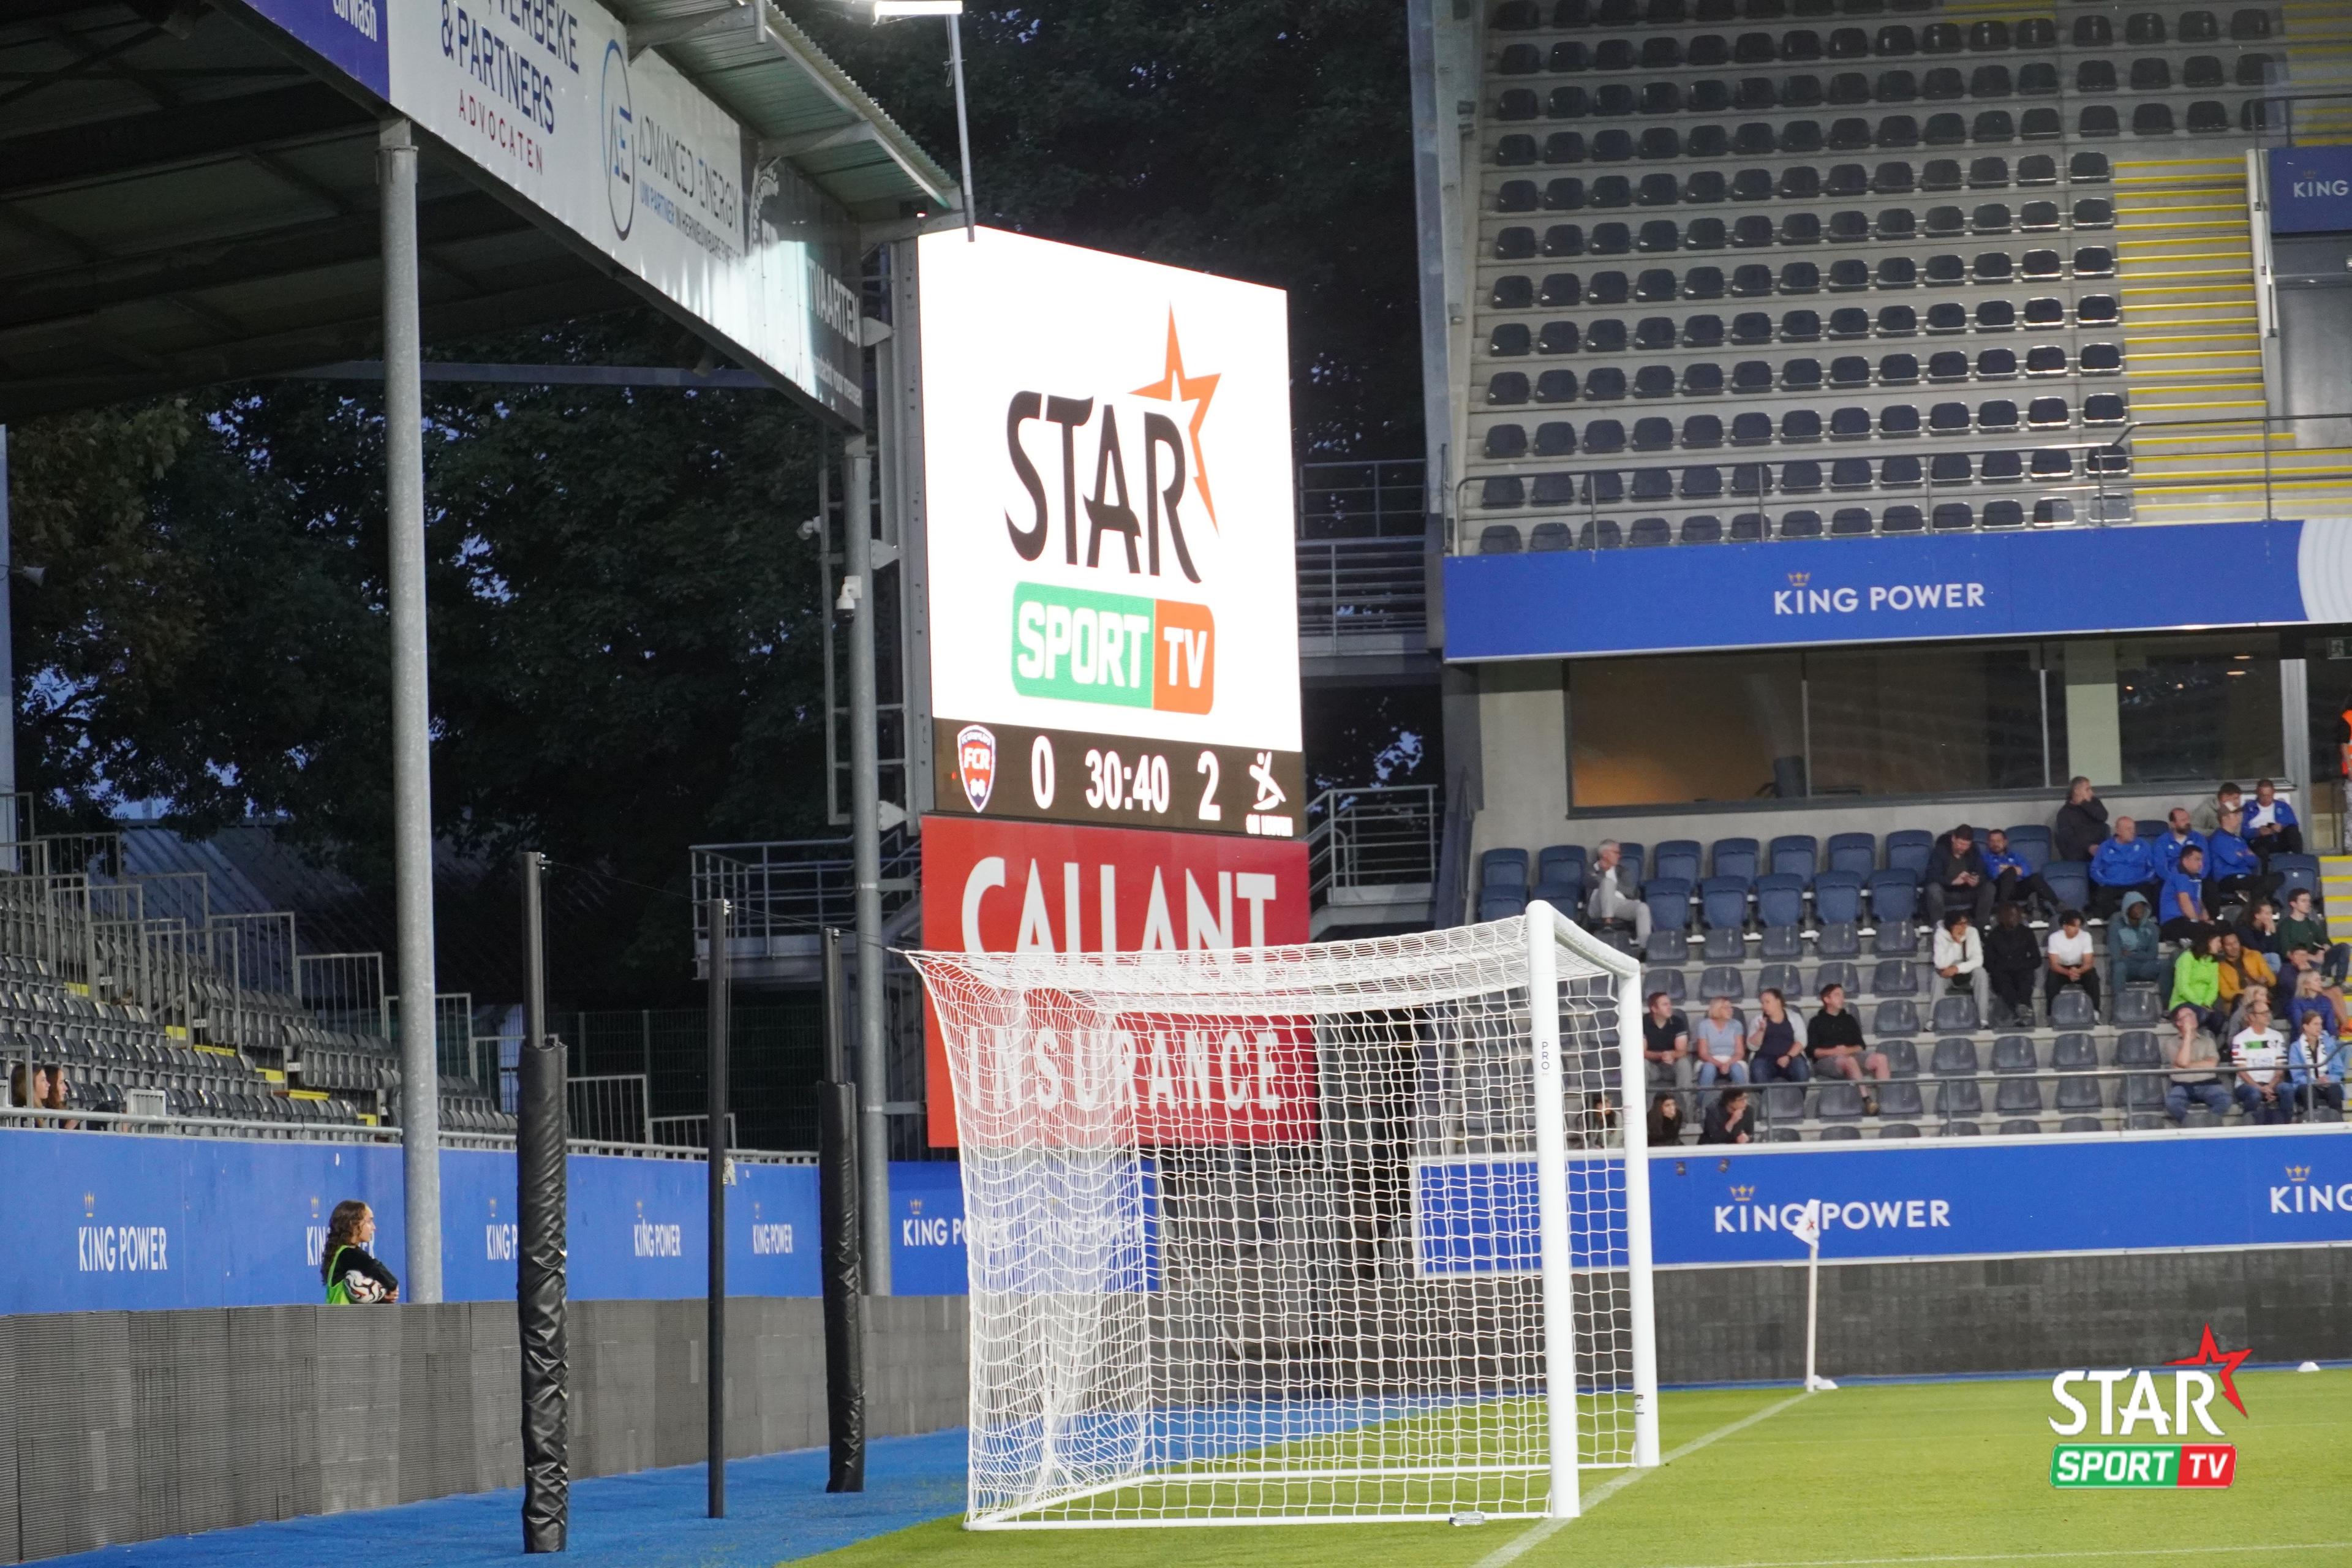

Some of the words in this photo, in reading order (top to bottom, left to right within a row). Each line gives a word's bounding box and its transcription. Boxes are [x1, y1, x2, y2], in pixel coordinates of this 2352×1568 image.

[441, 0, 454, 61] &
[458, 7, 554, 135] PARTNERS
[459, 89, 543, 176] ADVOCATEN
[2293, 179, 2350, 198] KING
[1005, 390, 1202, 584] STAR
[1774, 588, 1859, 615] KING
[1870, 582, 1985, 611] POWER
[1017, 600, 1150, 689] SPORT
[1163, 625, 1208, 689] TV
[1031, 735, 1055, 810] 0
[1085, 749, 1170, 814] 30:40
[1197, 750, 1221, 821] 2
[968, 1027, 1281, 1111] INSURANCE
[1541, 1041, 1550, 1070] PRO
[903, 1218, 948, 1246] KING
[1715, 1203, 1808, 1233] KING
[1822, 1200, 1951, 1231] POWER
[78, 1226, 116, 1272] KING
[119, 1226, 167, 1272] POWER
[307, 1226, 331, 1266] KIN
[486, 1223, 510, 1261] KING
[634, 1223, 654, 1258] KING
[655, 1224, 681, 1257] POWER
[752, 1224, 770, 1255] KING
[770, 1224, 793, 1255] POWER
